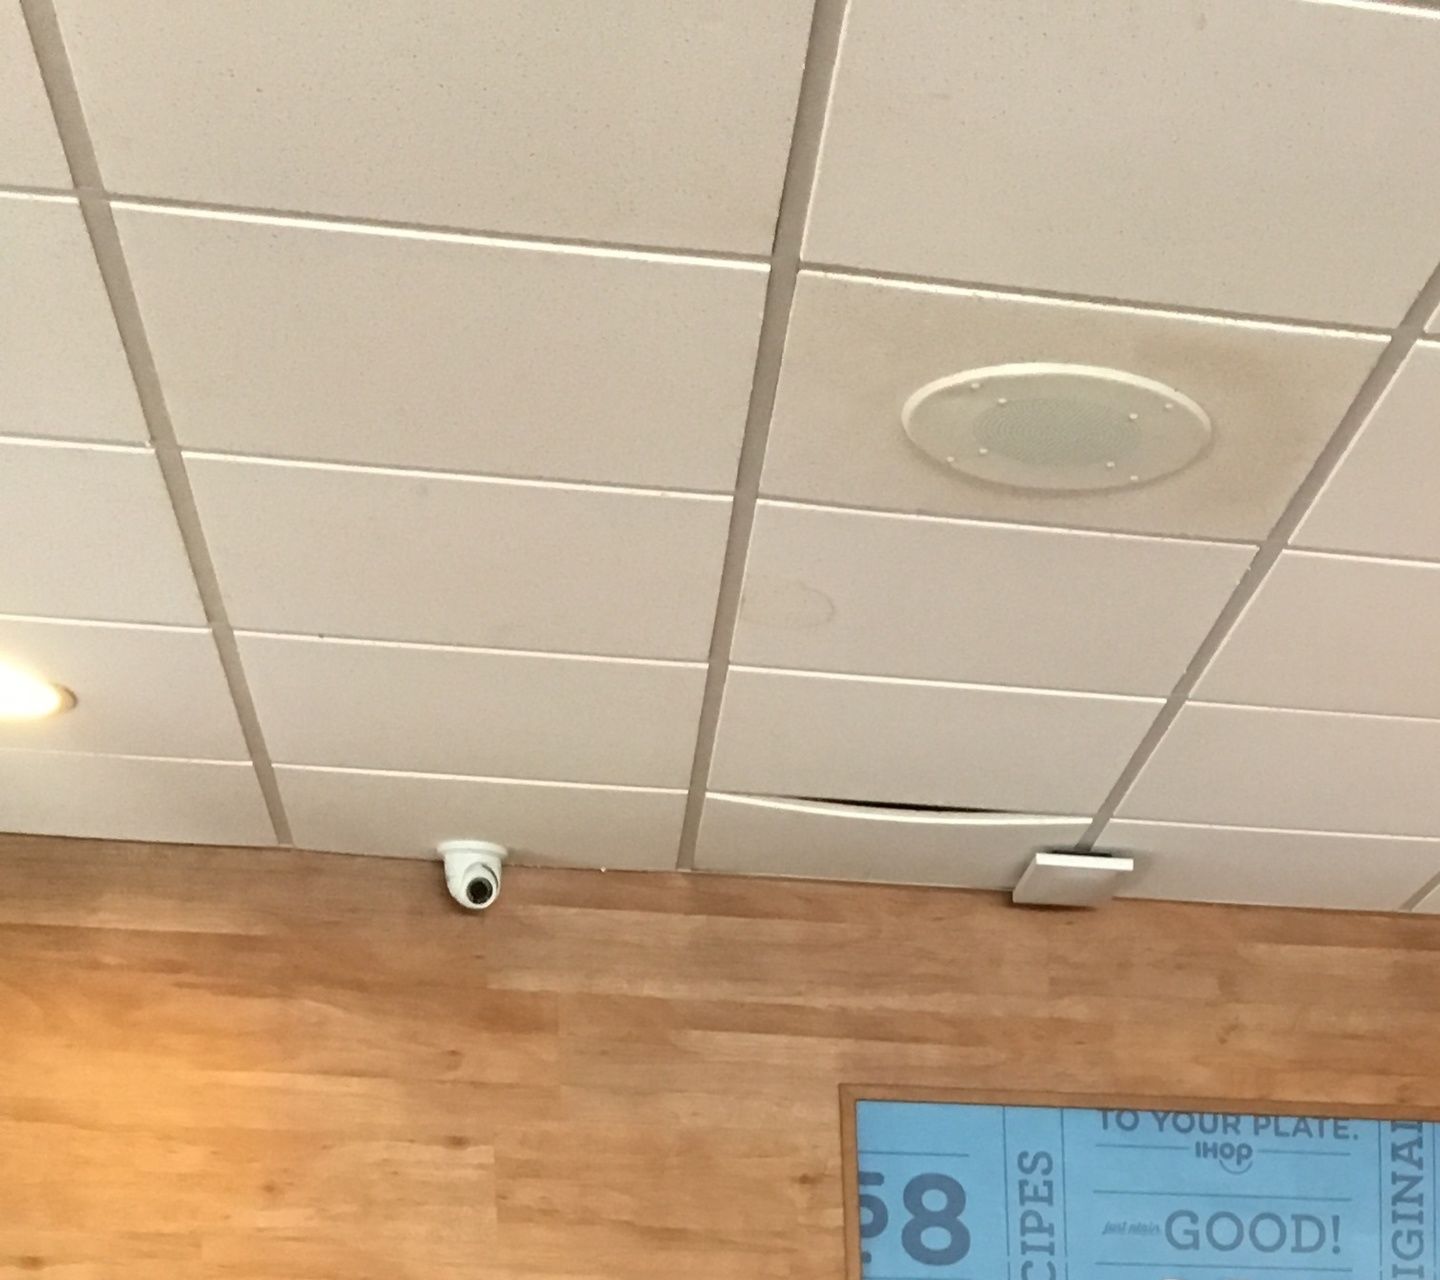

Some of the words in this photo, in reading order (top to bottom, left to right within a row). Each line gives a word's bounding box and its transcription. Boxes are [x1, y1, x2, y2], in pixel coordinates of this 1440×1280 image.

[1152, 1112, 1241, 1135] YOUR
[1254, 1115, 1359, 1140] PLATE.
[1195, 1141, 1253, 1167] IHOP
[1165, 1209, 1341, 1255] GOOD!
